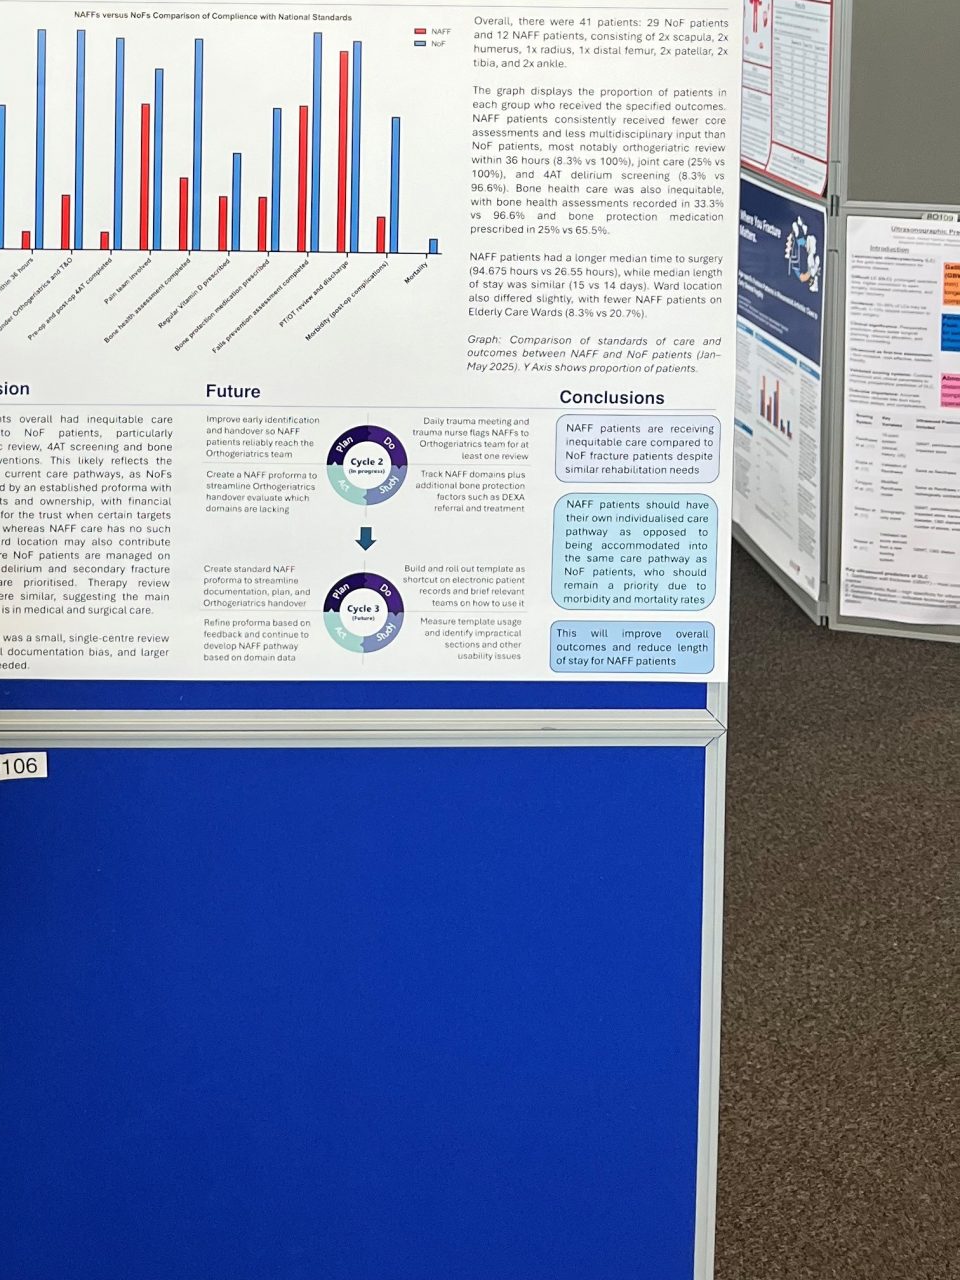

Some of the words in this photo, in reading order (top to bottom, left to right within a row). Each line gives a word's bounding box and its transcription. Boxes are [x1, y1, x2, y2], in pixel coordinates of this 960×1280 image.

[74, 10, 101, 19] NAFFs
[130, 11, 151, 19] NoFs
[152, 11, 201, 21] Comparison
[201, 12, 211, 20] of
[259, 13, 277, 21] with
[278, 13, 311, 21] National
[312, 13, 353, 22] Standards
[473, 16, 513, 27] Overall,
[518, 16, 545, 26] there
[549, 18, 575, 27] were
[579, 17, 591, 27] 41
[597, 18, 642, 29] patients:
[646, 18, 660, 27] 29
[664, 18, 685, 28] NoF
[689, 19, 729, 29] patients
[431, 40, 446, 48] NoF
[404, 262, 428, 284] Mortality
[206, 383, 261, 399] Future
[559, 389, 665, 405] Conclusions
[566, 423, 594, 433] NAFF
[600, 424, 641, 435] patients
[647, 425, 664, 434] are
[670, 425, 715, 436] receiving
[336, 437, 353, 452] Plan
[384, 437, 395, 449] Do
[350, 457, 376, 468] Cycle
[377, 457, 384, 466] 2
[379, 475, 399, 493] Study
[333, 584, 350, 599] Plan
[380, 584, 391, 596] Do
[347, 604, 372, 615] Cycle
[374, 604, 380, 613] 3
[377, 623, 396, 641] Study
